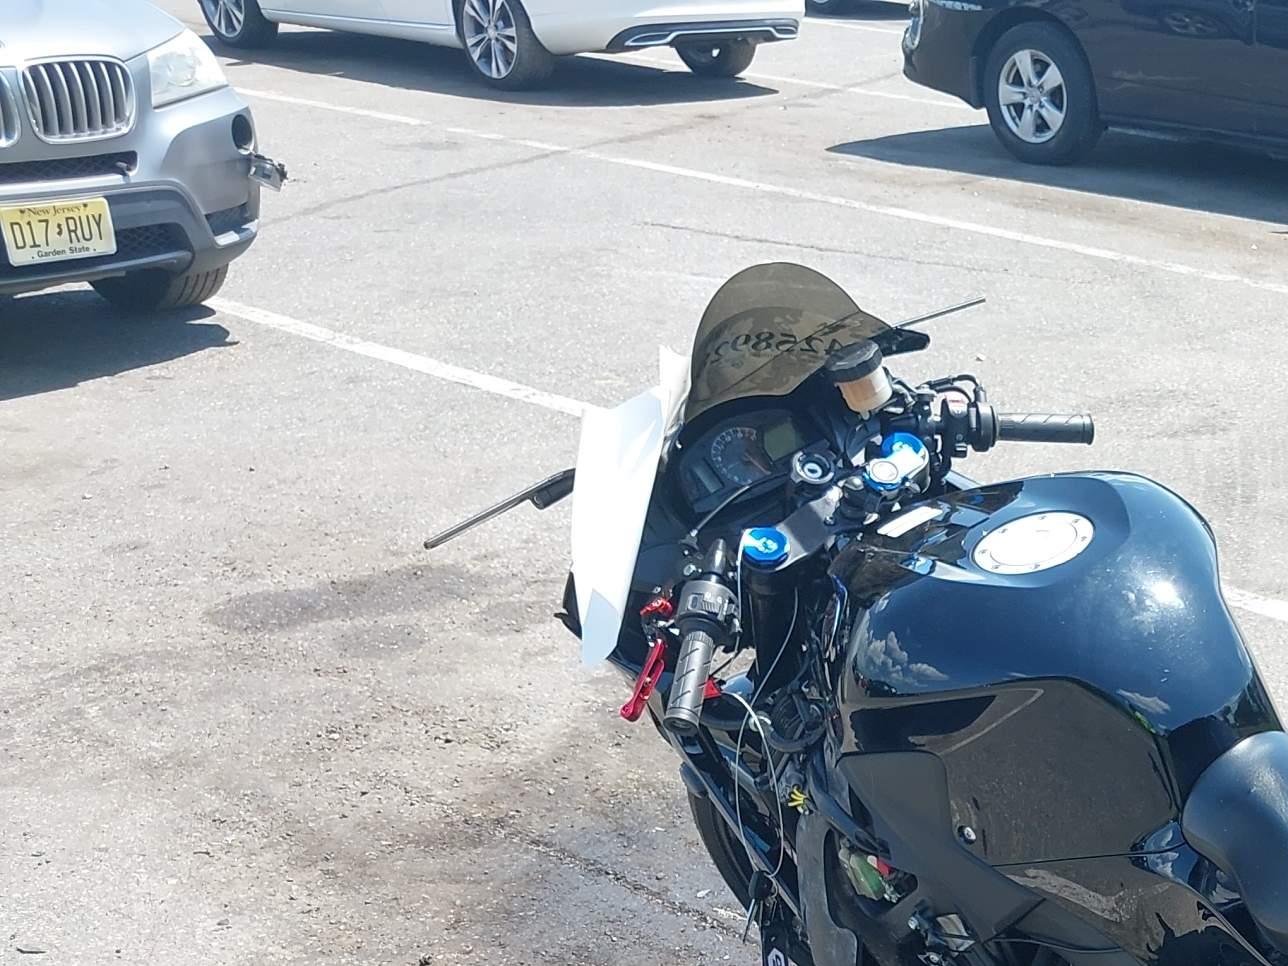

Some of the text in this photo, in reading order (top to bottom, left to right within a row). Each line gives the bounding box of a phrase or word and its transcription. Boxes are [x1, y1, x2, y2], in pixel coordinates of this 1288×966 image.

[27, 205, 82, 217] New Jersey
[36, 246, 90, 258] Garden State
